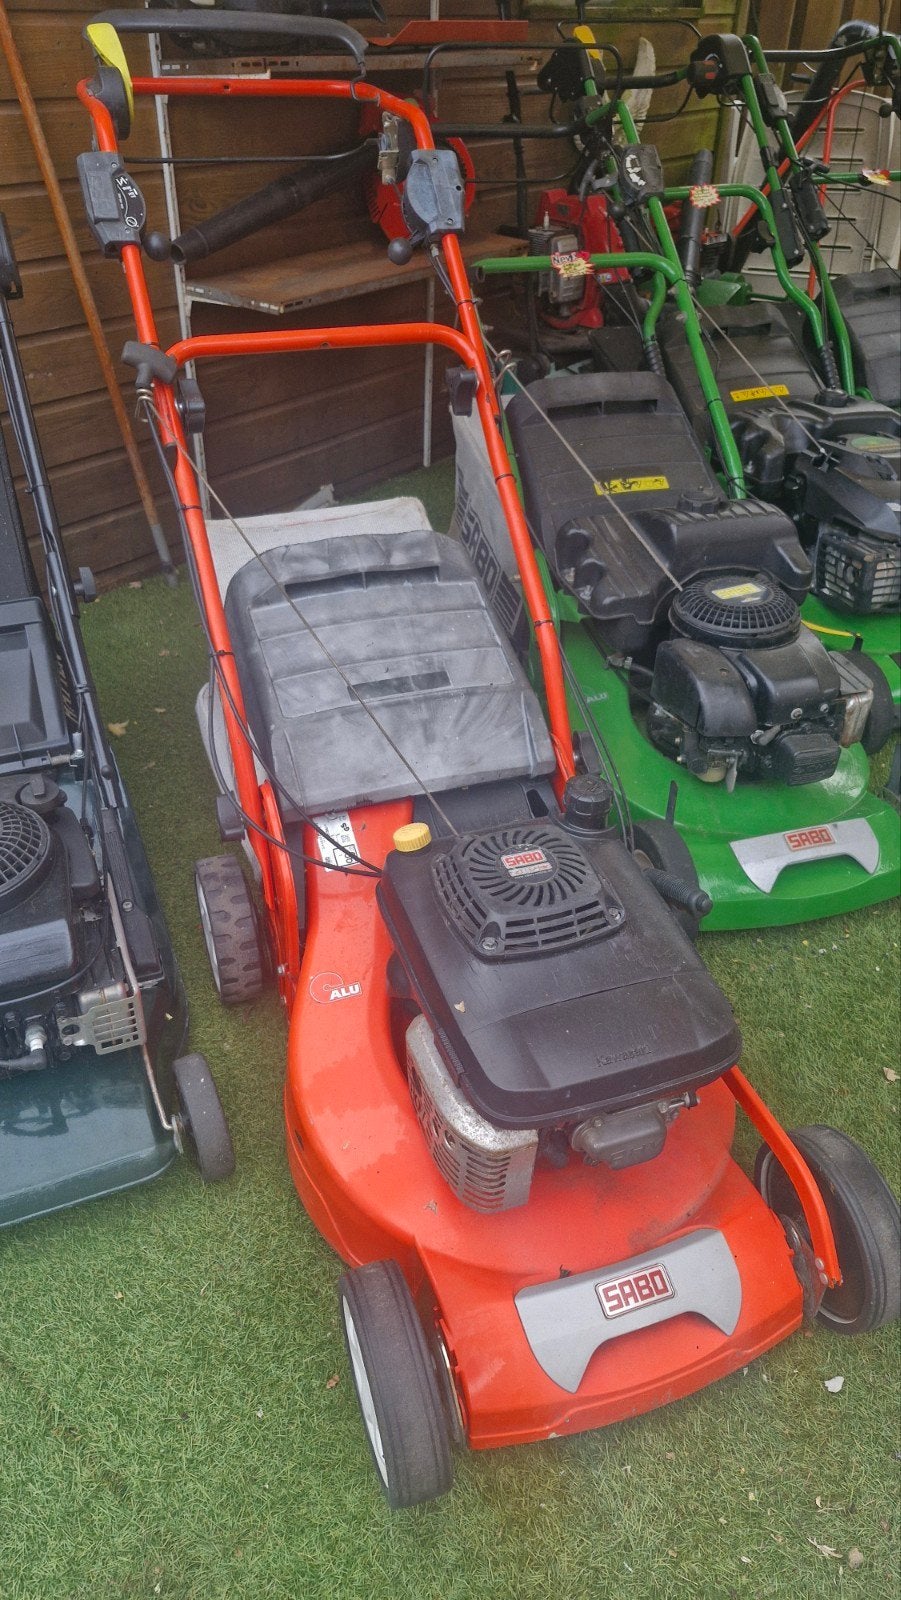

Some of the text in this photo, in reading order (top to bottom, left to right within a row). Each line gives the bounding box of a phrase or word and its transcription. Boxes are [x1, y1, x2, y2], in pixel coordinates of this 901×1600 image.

[461, 510, 498, 597] SABO
[786, 829, 833, 848] SABO
[504, 851, 544, 867] SABO
[329, 984, 361, 1001] ALU
[602, 1269, 669, 1312] SABO
